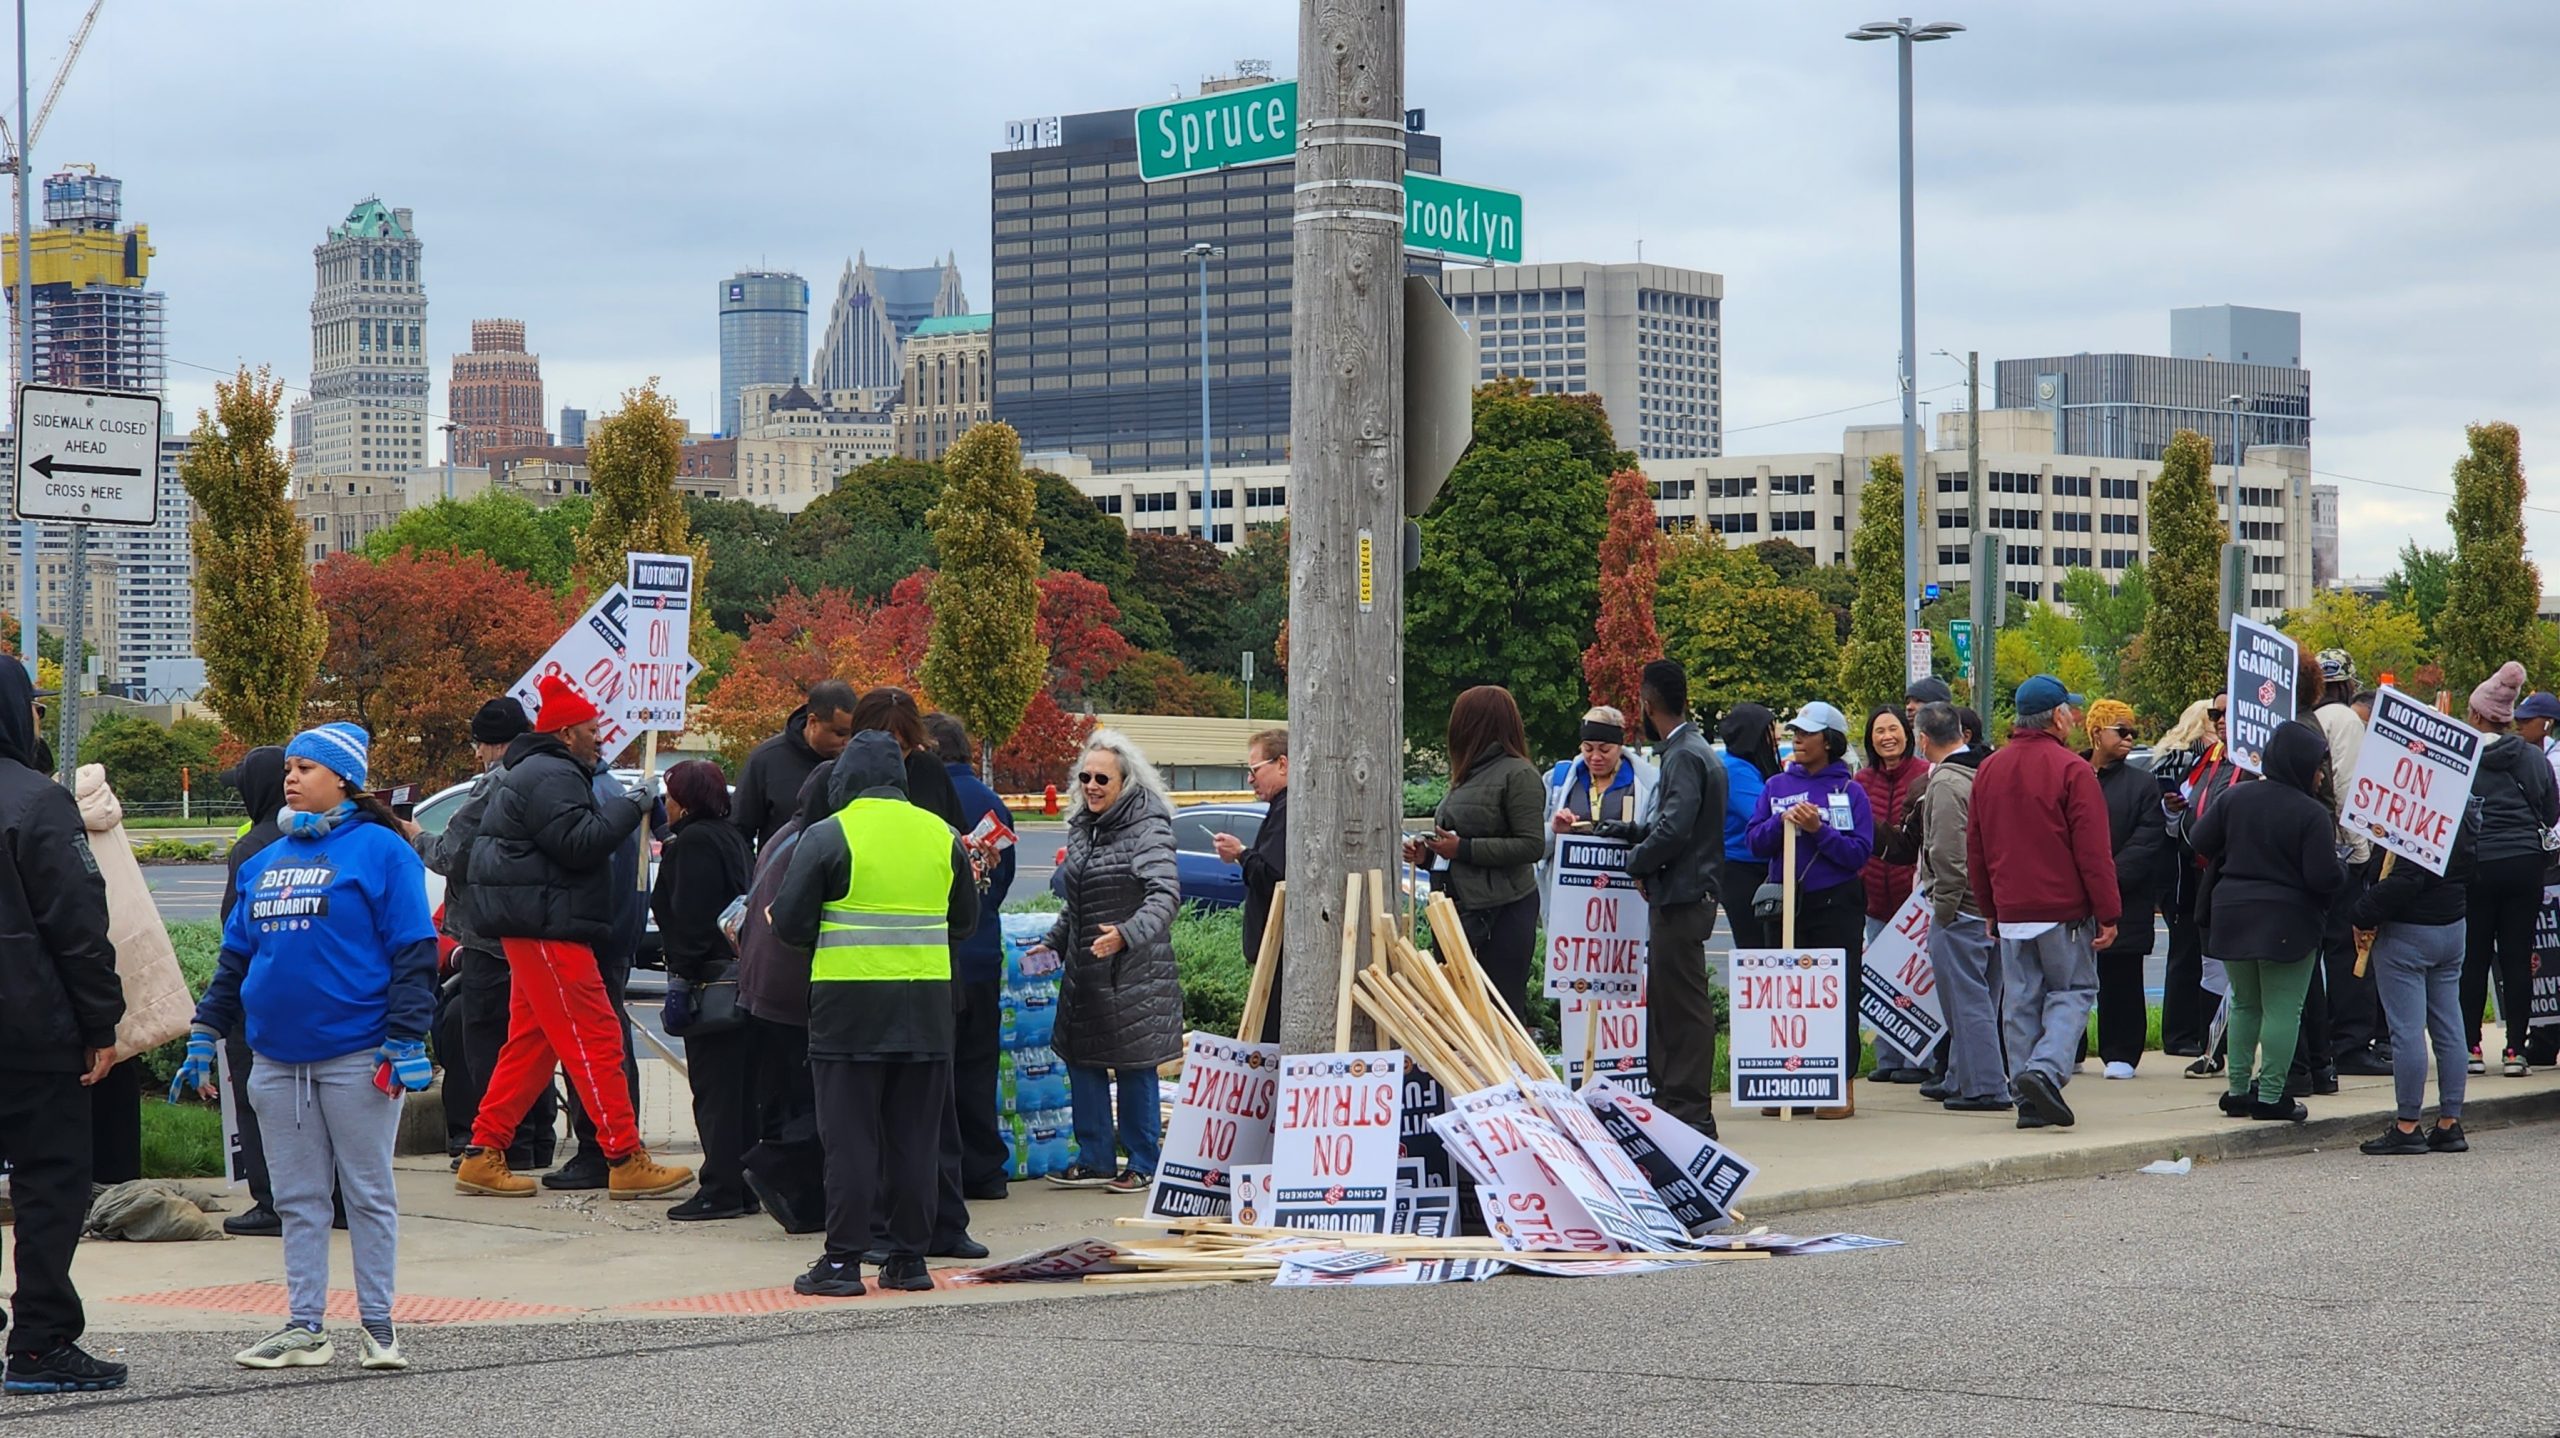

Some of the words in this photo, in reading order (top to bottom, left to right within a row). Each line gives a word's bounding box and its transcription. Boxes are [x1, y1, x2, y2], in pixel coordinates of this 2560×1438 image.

[1005, 116, 1058, 145] DTE
[1159, 98, 1286, 169] Spruce
[1404, 188, 1514, 255] rooklyn
[33, 414, 94, 431] SIDEWALK
[99, 419, 147, 435] CLOSED
[64, 440, 107, 454] AHEAD
[45, 483, 86, 498] CROSS
[91, 486, 123, 500] HERE
[638, 563, 686, 587] MOTORCITY
[633, 598, 655, 607] CASINO
[592, 620, 620, 648] CASINO
[649, 619, 671, 658] ON
[2252, 635, 2283, 661] DON'T
[584, 658, 625, 705] ON
[628, 662, 684, 702] STRIKE
[2238, 649, 2291, 690] GAMBLE
[2238, 700, 2269, 725] WITH
[2387, 701, 2470, 752] MOTORCITY
[2377, 725, 2407, 745] CASINO
[2427, 750, 2468, 773] WORKERS
[2393, 757, 2434, 800] ON
[2354, 777, 2453, 849] STRIKE
[260, 867, 331, 890] DETROIT
[1561, 876, 1591, 885] CASINO
[253, 896, 321, 919] SOLIDARITY
[1585, 897, 1618, 933] ON
[1553, 935, 1640, 975] STRIKE
[1862, 966, 1896, 997] WORKERS
[1896, 952, 1937, 997] ON
[1738, 975, 1839, 1010] STRIKE
[1601, 1013, 1638, 1050] ON
[1770, 1014, 1807, 1049] ON
[1910, 1007, 1937, 1029] CASINO
[1182, 1063, 1276, 1121] STRIKE
[1747, 1078, 1830, 1097] MOTORCITY
[1283, 1084, 1394, 1129] STRIKE
[1198, 1116, 1237, 1162] ON
[1312, 1133, 1353, 1177] ON
[1165, 1165, 1203, 1179] WORKERS
[1690, 1148, 1712, 1176] CASINO
[1279, 1191, 1323, 1199] WORKERS
[1346, 1190, 1384, 1198] CASINO
[1285, 1213, 1376, 1233] MOTORCITY
